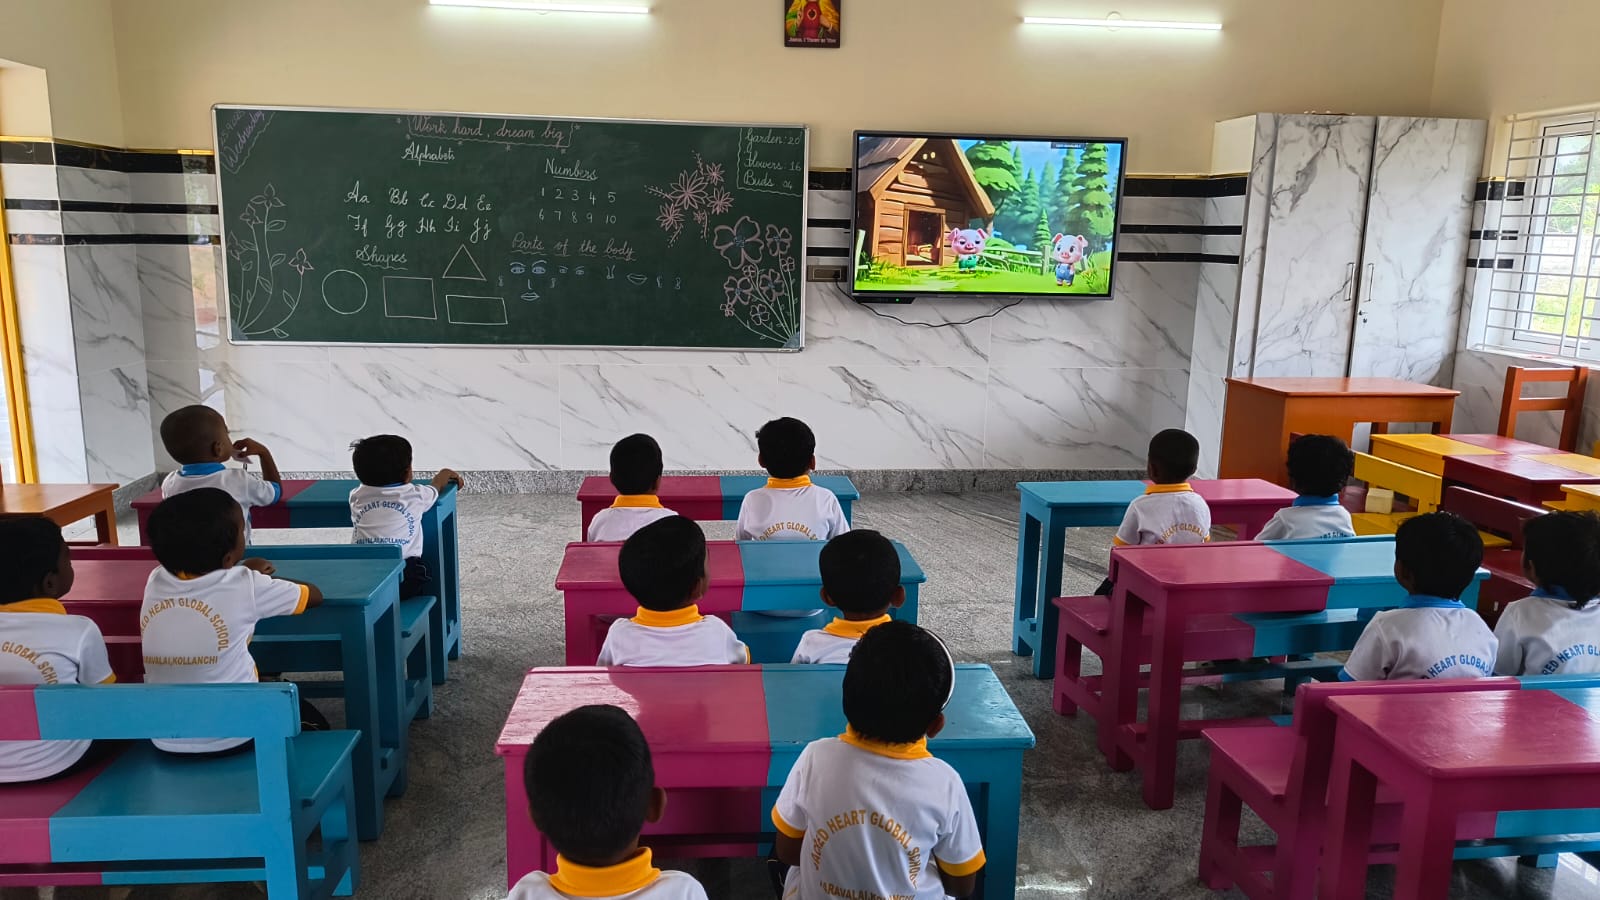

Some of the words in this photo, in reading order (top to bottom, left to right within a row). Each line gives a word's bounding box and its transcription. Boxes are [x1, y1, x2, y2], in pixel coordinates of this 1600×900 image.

[411, 117, 448, 134] Work
[496, 120, 535, 138] dream
[401, 141, 455, 166] Alphabets
[545, 158, 599, 180] Numbers
[343, 180, 370, 204] Aa
[389, 187, 409, 206] Bb
[419, 192, 436, 208] Cc
[442, 193, 468, 210] Dd
[477, 193, 492, 211] Ee
[554, 188, 564, 199] 2
[571, 189, 580, 201] 3
[589, 191, 597, 206] 4
[607, 191, 617, 203] 5
[538, 208, 545, 221] 6
[553, 210, 562, 221] 7
[571, 210, 578, 224] 8
[586, 212, 593, 223] 9
[605, 214, 617, 224] 10
[347, 214, 368, 238] Ff
[385, 214, 408, 239] Gg
[416, 216, 437, 234] Hh
[444, 215, 461, 232] Ii
[470, 217, 492, 244] Jj
[355, 244, 408, 268] Shapes
[512, 231, 545, 250] Parts
[553, 238, 569, 256] of
[579, 239, 598, 253] the
[604, 238, 632, 261] body
[765, 522, 785, 538] HEART
[786, 521, 812, 537] GLOBAL
[148, 598, 176, 617] HEART
[178, 597, 213, 618] GLOBAL
[209, 613, 229, 652] SCHOOL
[2, 641, 39, 665] GLOBAL
[1556, 644, 1585, 664] HEART
[1427, 655, 1457, 678] HEART
[826, 809, 866, 834] HEART
[870, 811, 913, 850] GLOBAL
